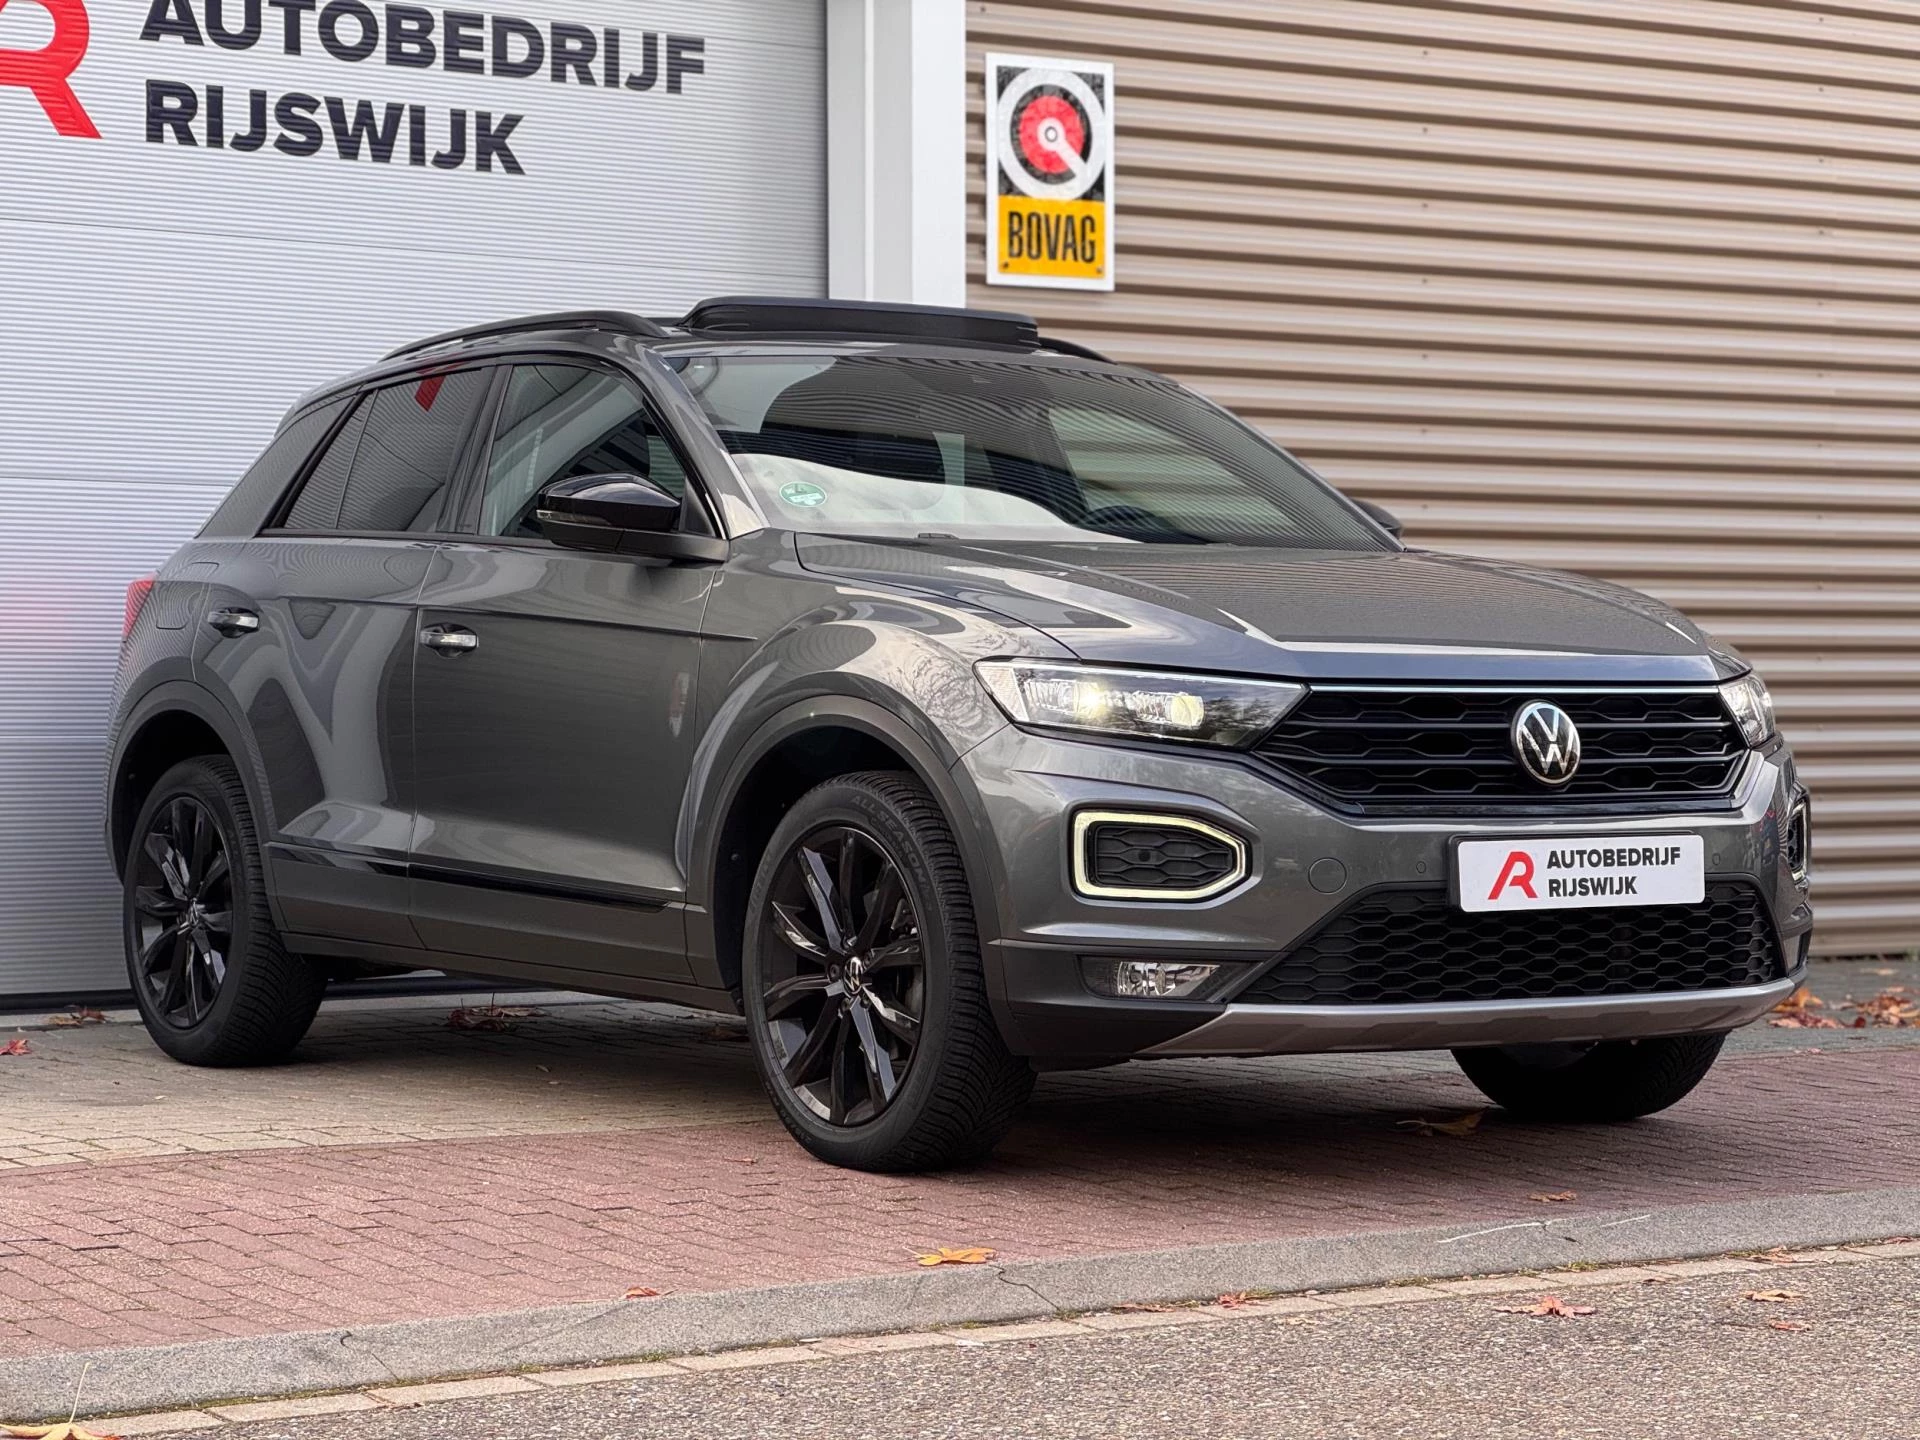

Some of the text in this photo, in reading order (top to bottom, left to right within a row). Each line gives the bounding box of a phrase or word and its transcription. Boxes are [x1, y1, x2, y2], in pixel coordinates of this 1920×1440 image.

[139, 0, 705, 94] AUTOBEDRIJF
[145, 79, 525, 175] RIJSWIJK
[1008, 211, 1095, 263] BOVAG
[1547, 847, 1680, 869] AUTOBEDRIJF
[1549, 876, 1637, 898] RIJSWIJK
